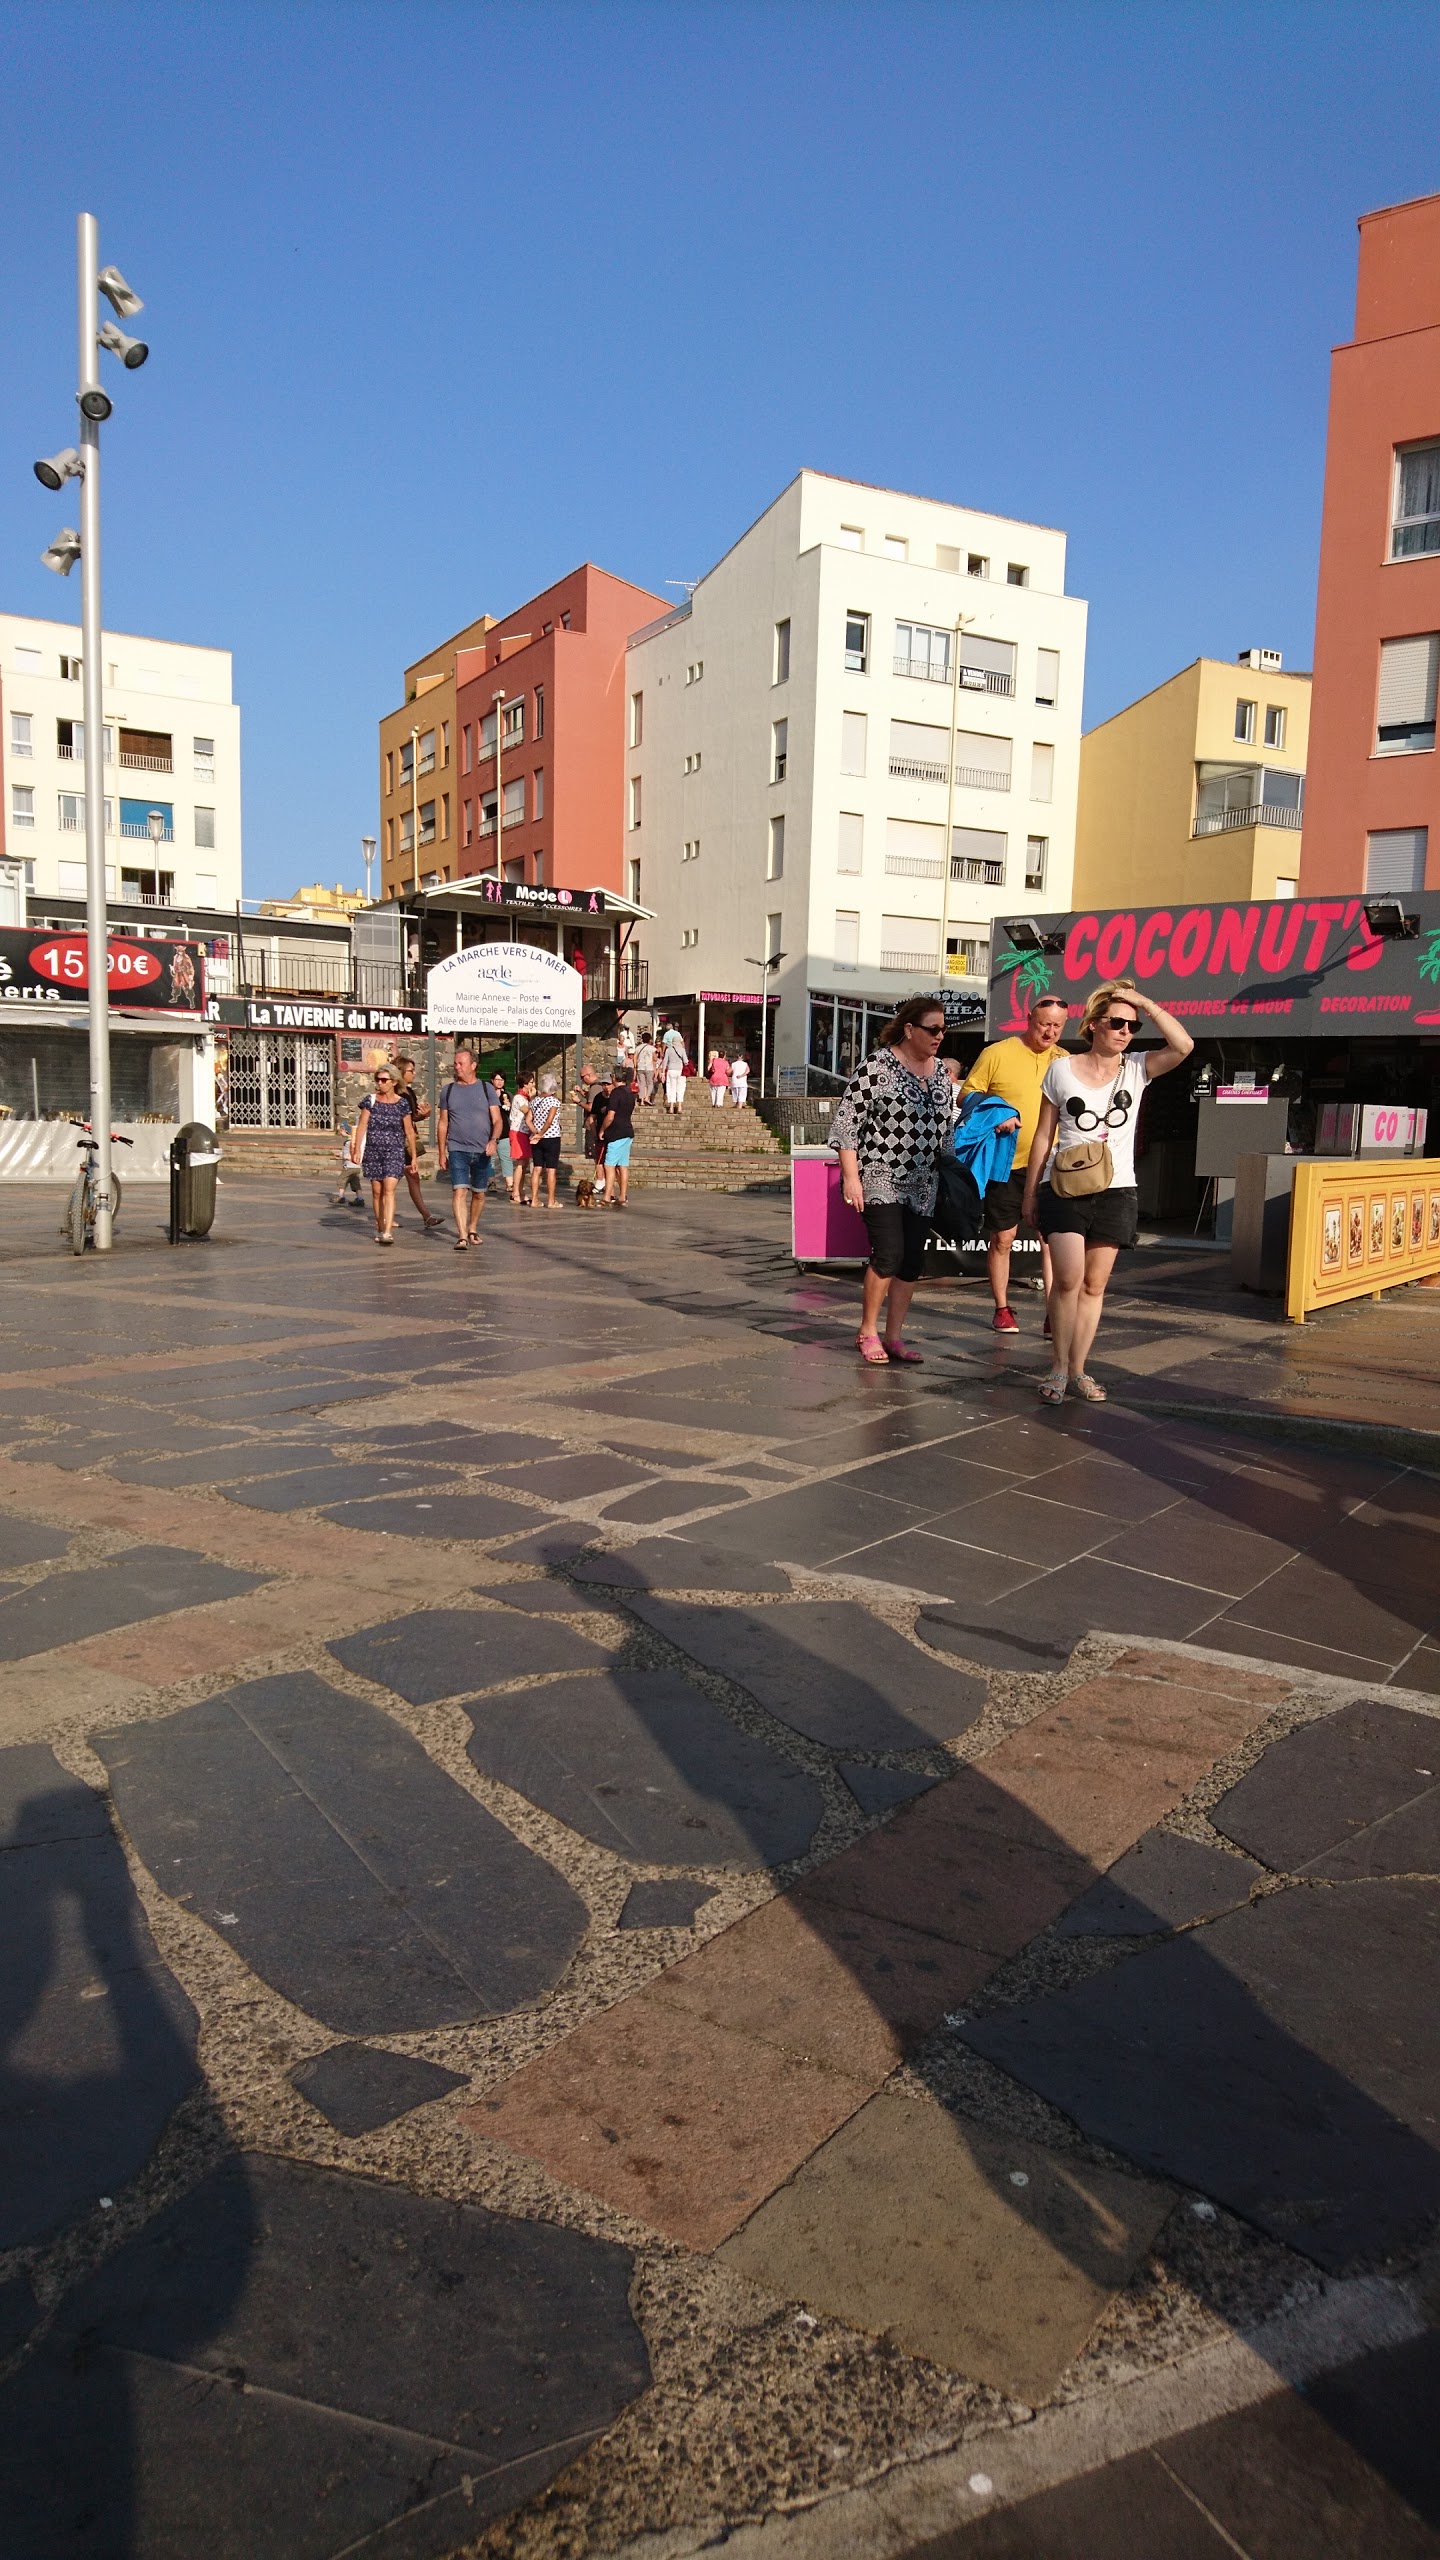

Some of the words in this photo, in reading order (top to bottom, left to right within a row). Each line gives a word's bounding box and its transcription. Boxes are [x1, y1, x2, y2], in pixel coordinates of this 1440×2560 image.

[516, 886, 557, 902] Mode
[506, 899, 535, 907] TEXTILES
[542, 903, 583, 912] ACCESSOIRES
[1063, 900, 1384, 981] COCONUT'S
[442, 960, 456, 973] LA
[457, 946, 499, 964] MARCHE
[502, 946, 528, 958] VERS
[530, 950, 542, 963] LA
[545, 957, 567, 975] MER
[478, 965, 512, 981] agde
[0, 984, 60, 1000] erts
[456, 992, 480, 1002] Mairie
[482, 993, 510, 1002] Annexe
[519, 994, 540, 1003] Poste
[433, 1004, 455, 1013] Police
[456, 1005, 498, 1017] Municipale
[507, 1006, 528, 1015] Palais
[530, 1006, 543, 1015] des
[1252, 998, 1293, 1014] MODE
[1320, 995, 1412, 1013] DECORATION
[251, 1003, 271, 1025] La
[273, 1005, 345, 1028] TAVERNE
[348, 1009, 366, 1030] du
[370, 1011, 413, 1032] Pirate
[438, 1017, 457, 1026] Allée
[459, 1017, 469, 1026] de
[470, 1017, 477, 1026] la
[479, 1017, 509, 1027] Flânerie
[518, 1019, 538, 1029] Plage
[540, 1019, 550, 1028] du
[553, 1019, 572, 1028] Môle
[962, 1239, 1042, 1252] MASIN
